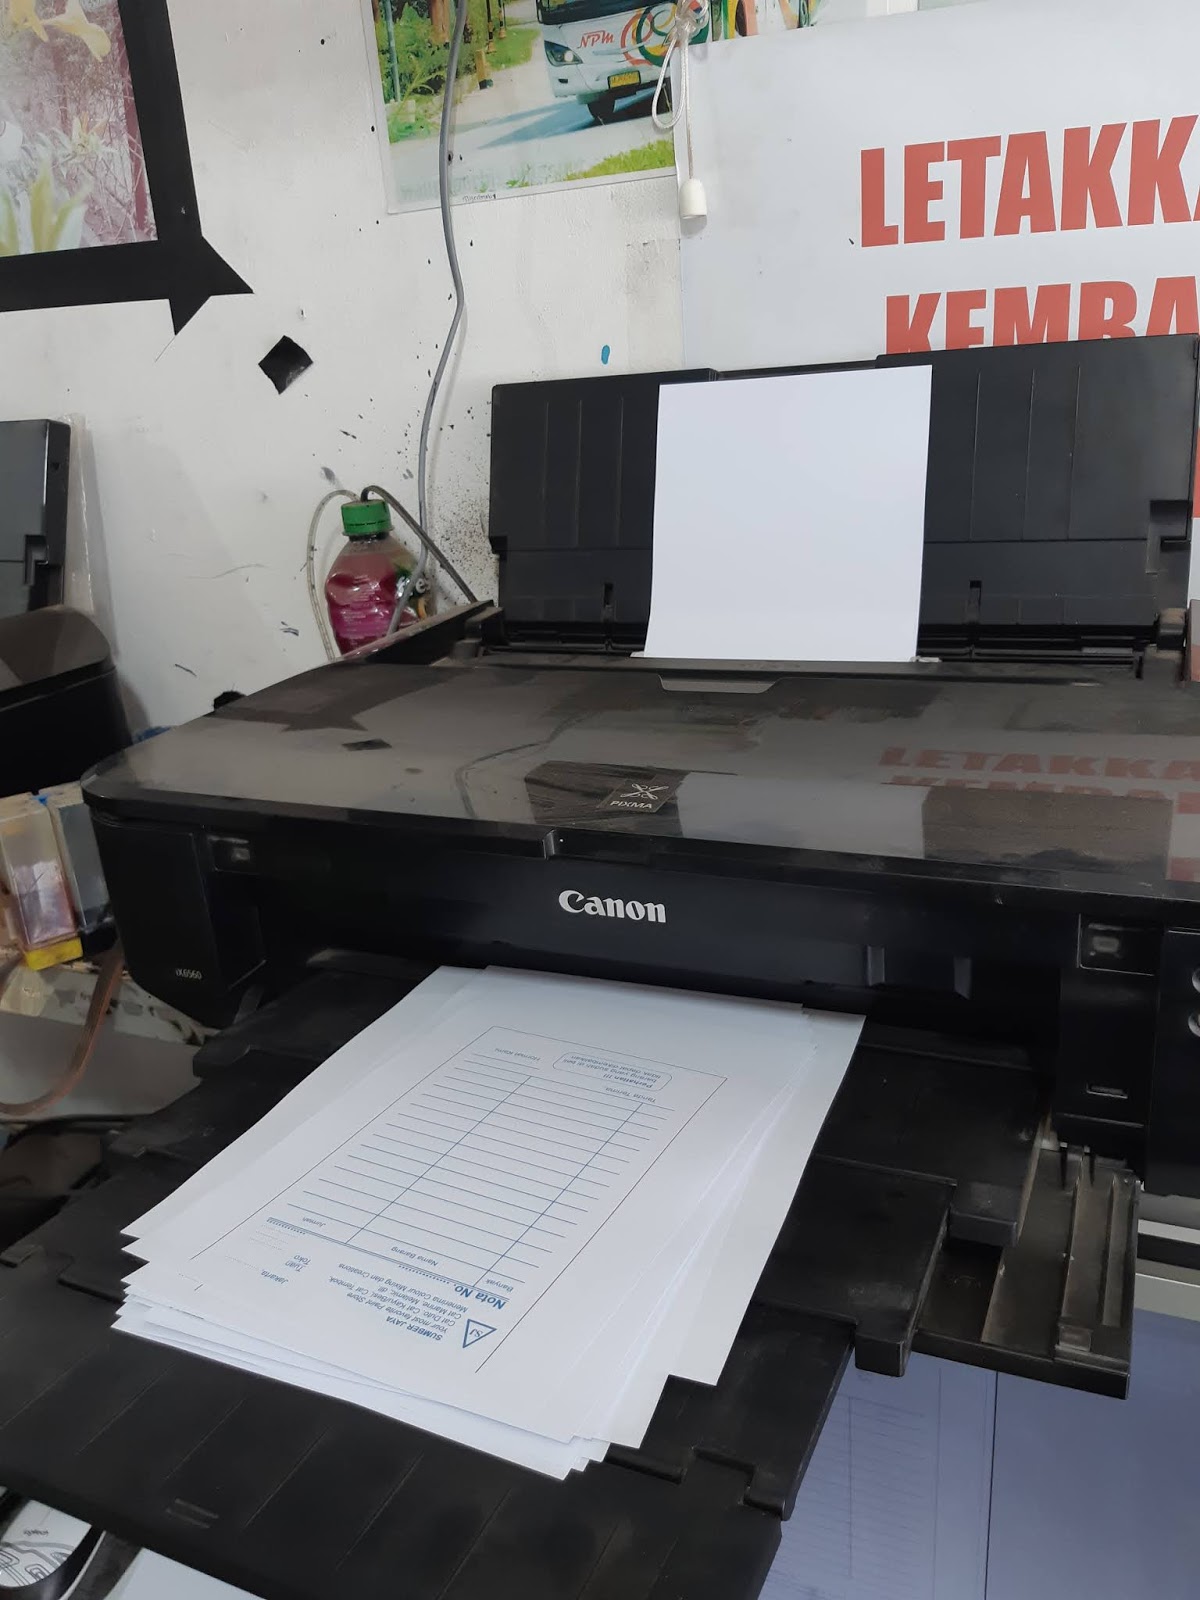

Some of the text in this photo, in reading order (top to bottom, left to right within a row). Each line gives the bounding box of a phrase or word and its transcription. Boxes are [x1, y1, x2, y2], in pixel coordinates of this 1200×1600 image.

[860, 114, 1200, 248] LETAKK
[610, 800, 653, 809] PIXMA
[558, 889, 666, 923] Canon
[613, 1075, 653, 1088] Perhatian
[293, 1255, 310, 1265] Toko
[391, 1246, 438, 1266] Nama Barang
[285, 1260, 303, 1271] Tuan
[339, 1263, 468, 1312] Menerima Colour Mixing dan Creations
[355, 1285, 369, 1295] Cat
[485, 1278, 513, 1292] Banyak
[475, 1292, 506, 1309] Nota
[346, 1292, 448, 1333] Your most favorite Paint Store
[407, 1305, 421, 1315] Cat
[448, 1310, 461, 1319] Cat
[385, 1315, 443, 1340] SUMBER JAYA
[442, 1317, 455, 1327] Cat
